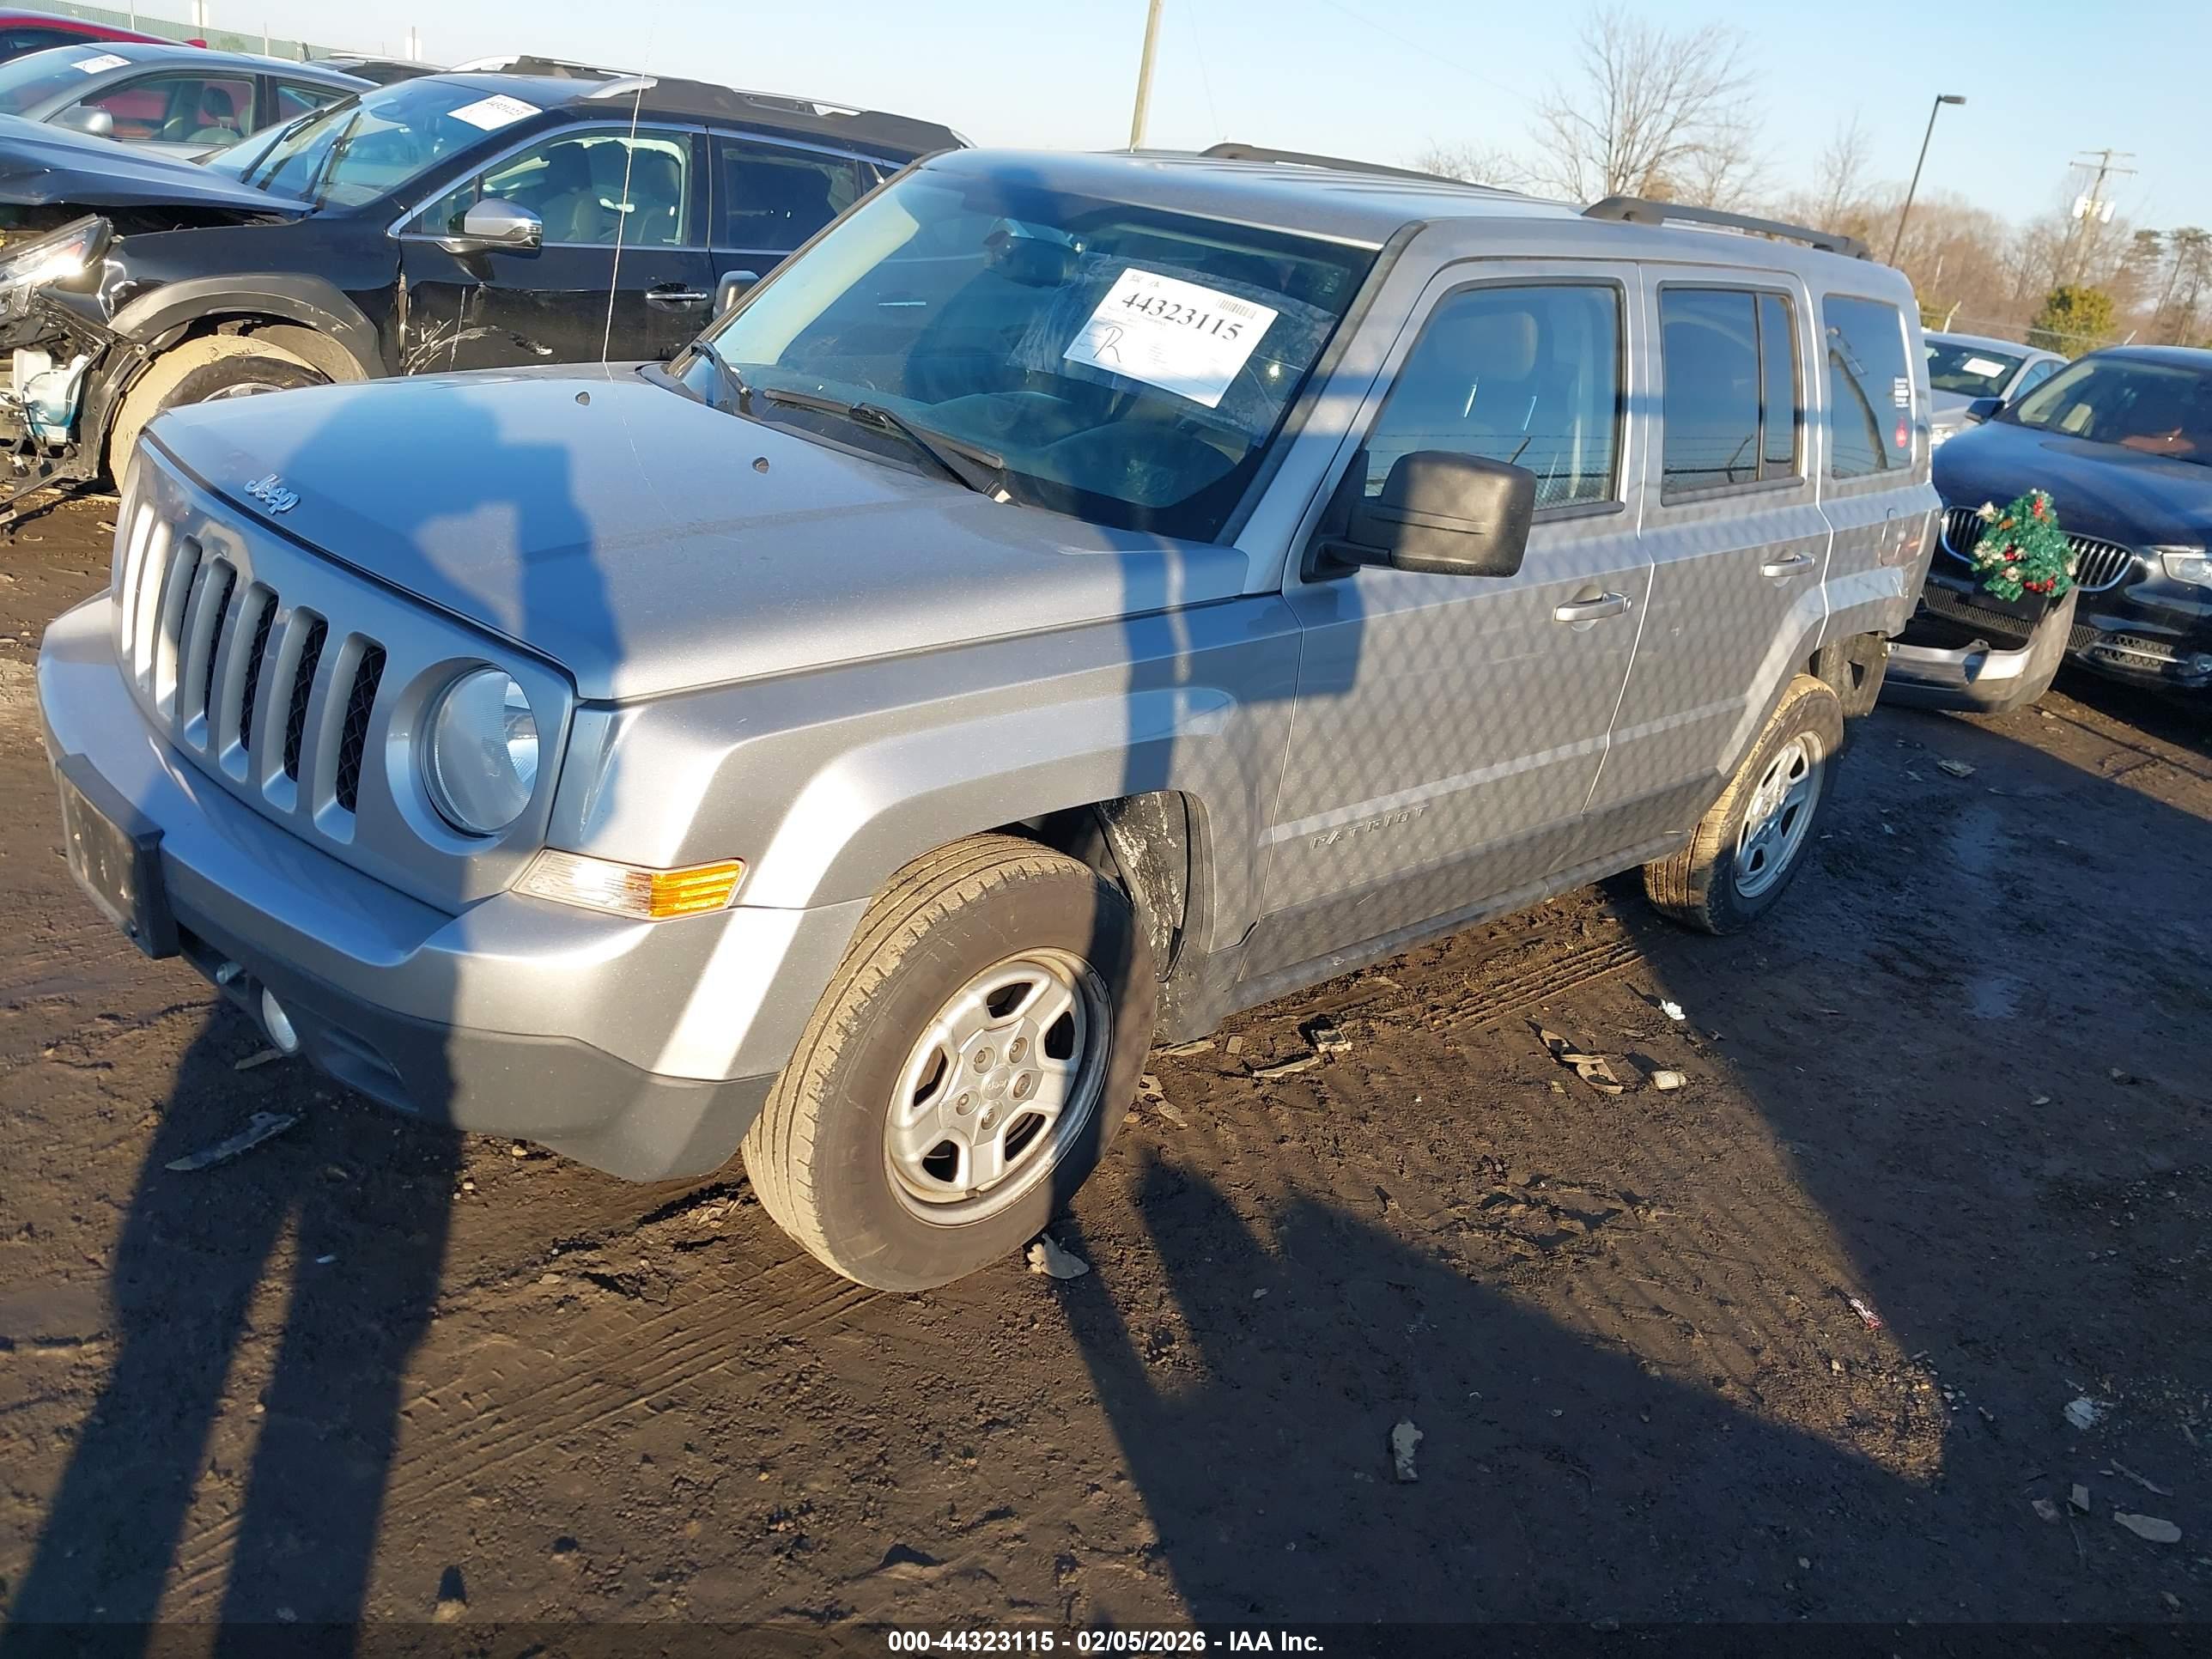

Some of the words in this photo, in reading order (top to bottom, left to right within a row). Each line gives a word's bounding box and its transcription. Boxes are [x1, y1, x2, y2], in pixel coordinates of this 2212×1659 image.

[1121, 292, 1244, 340] 44323115
[244, 473, 300, 515] Jeep
[1310, 804, 1430, 849] PATRIOT
